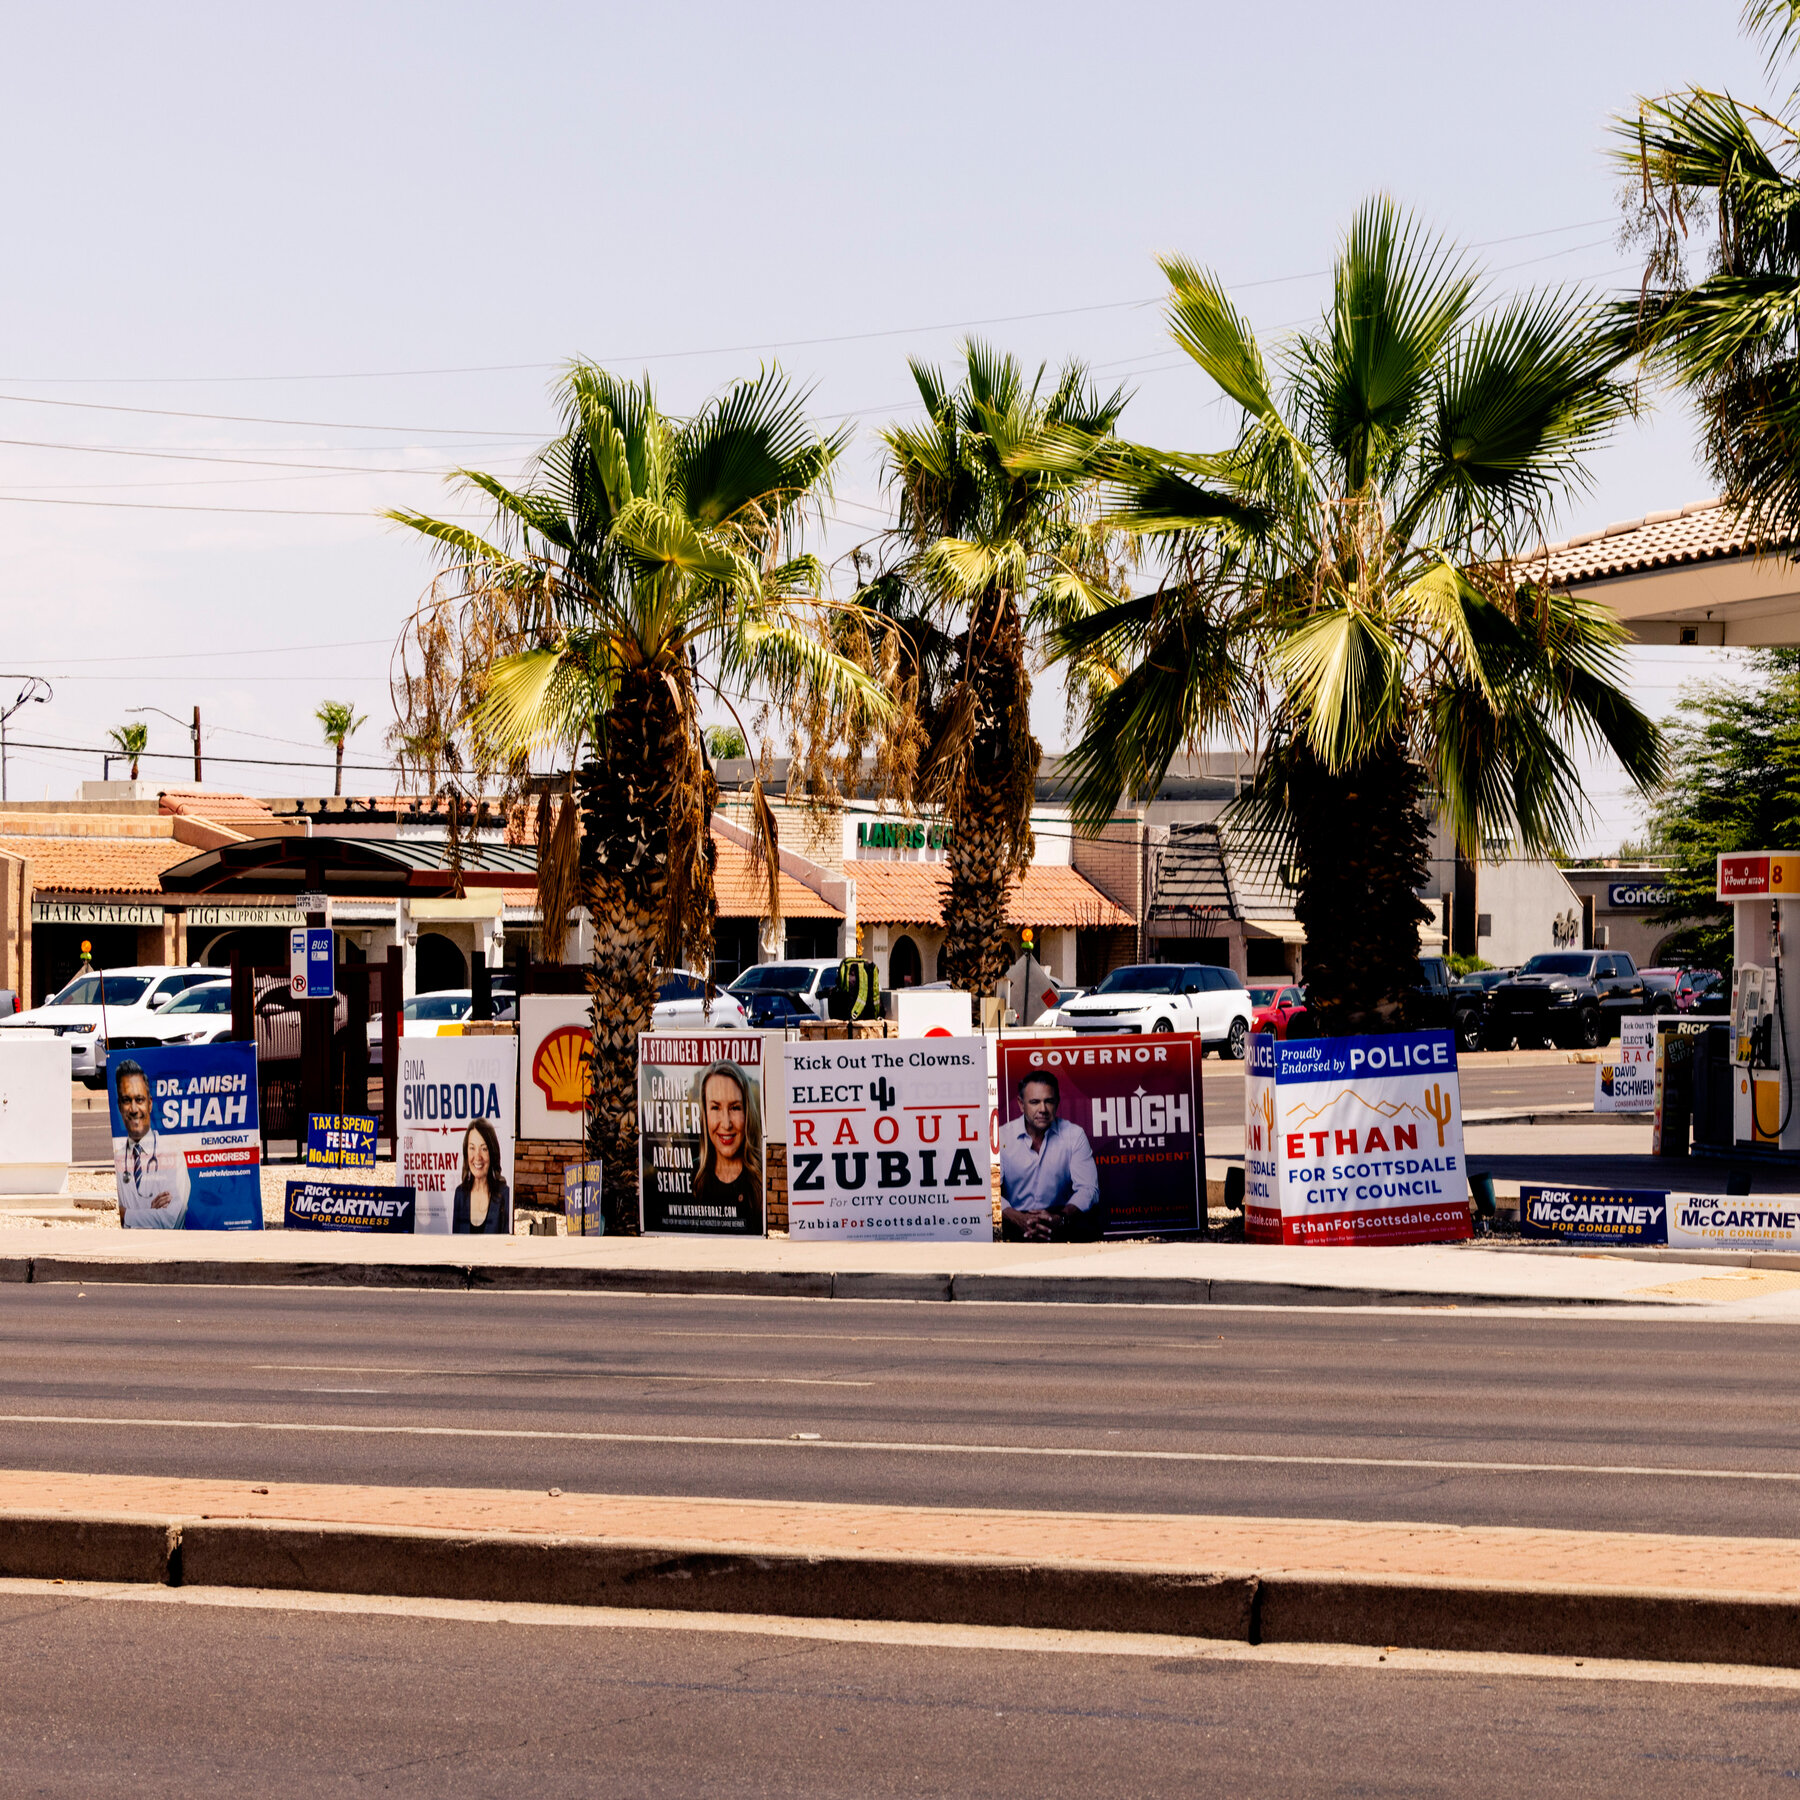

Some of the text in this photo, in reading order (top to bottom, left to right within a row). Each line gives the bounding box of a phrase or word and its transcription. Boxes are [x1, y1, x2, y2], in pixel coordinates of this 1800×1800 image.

[1725, 875, 1747, 886] V-Power
[1772, 865, 1783, 884] 8
[40, 904, 155, 923] HAIR STALGIA
[188, 908, 220, 924] TIGI
[225, 910, 270, 923] SUPPORT
[311, 940, 329, 950] BUS
[1677, 1021, 1710, 1035] RICK
[1623, 1035, 1645, 1045] ELECT
[643, 1039, 759, 1063] A STRONGER ARIZONA
[1029, 1046, 1168, 1067] GOVERNOR
[1280, 1047, 1322, 1062] Proudly
[1350, 1042, 1449, 1071] POLICE
[404, 1059, 426, 1081] GINA
[794, 1052, 976, 1071] Kick Out The Clowns.
[1281, 1058, 1346, 1075] Endorsed by
[1614, 1065, 1637, 1078] DAVID
[157, 1074, 247, 1097] DR. AMISH
[652, 1076, 690, 1101] CARINE
[793, 1084, 864, 1104] ELECT
[403, 1083, 501, 1120] SWOBODA
[162, 1095, 248, 1130] SHAH
[644, 1100, 702, 1135] WERNER
[1091, 1093, 1190, 1138] HUGH
[312, 1116, 375, 1134] TAX & SPEND
[793, 1114, 979, 1147] RAOUL
[201, 1134, 250, 1146] DEMOCRAT
[326, 1131, 359, 1149] FEELY
[404, 1136, 418, 1150] FOR
[1119, 1136, 1166, 1149] LYTLE
[1286, 1123, 1419, 1159] ETHAN
[187, 1151, 251, 1164] U.S. CONGRESS
[404, 1152, 459, 1171] SECRETARY
[653, 1146, 694, 1169] ARIZONA
[1095, 1151, 1191, 1166] INDEPENDENT
[578, 1164, 600, 1183] GABBER
[793, 1148, 983, 1191] ZUBIA
[1289, 1156, 1458, 1184] FOR SCOTTSDALE
[304, 1184, 331, 1197] RICK
[404, 1173, 446, 1192] OF STATE
[657, 1171, 693, 1193] SENATE
[575, 1186, 592, 1209] FELY
[830, 1193, 950, 1208] For CITY COUNCIL
[1306, 1180, 1443, 1204] CITY COUNCIL
[1541, 1190, 1571, 1204] RICK
[296, 1195, 410, 1218] McCARTNEY
[668, 1203, 738, 1219] WWW.WERNERFORAZ.COM
[1689, 1197, 1719, 1209] RICK
[312, 1214, 390, 1226] FOR CONGRESS
[798, 1215, 981, 1230] ZubiaForScottsdale.com
[1533, 1202, 1664, 1225] McCARTNEY
[1292, 1211, 1463, 1236] EthanForScottsdale.com
[1552, 1222, 1643, 1235] FOR CONGRESS
[1702, 1229, 1792, 1240] FOR CONGRESS
